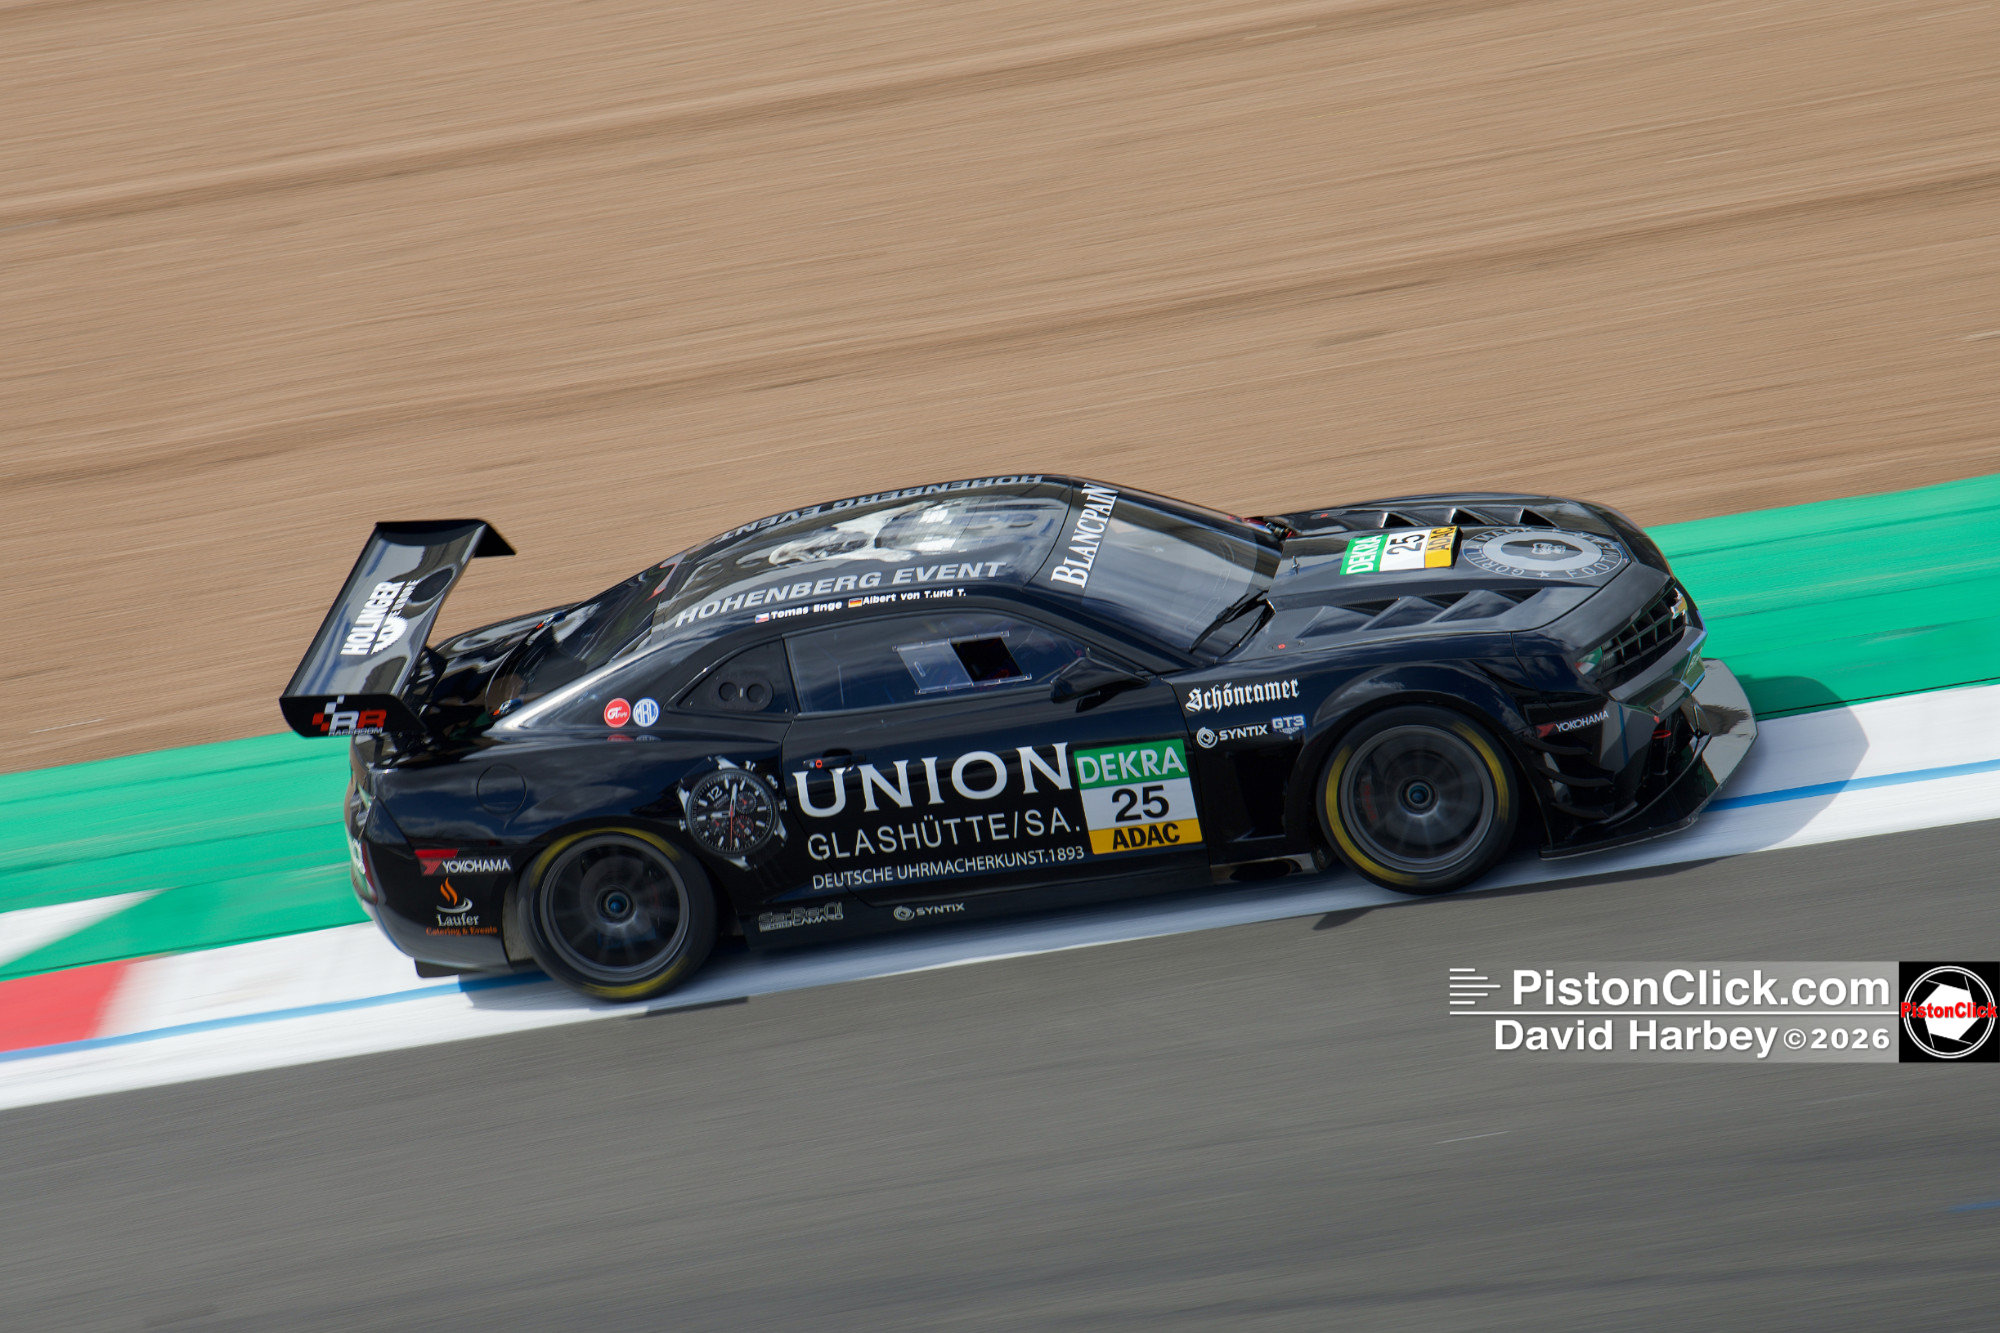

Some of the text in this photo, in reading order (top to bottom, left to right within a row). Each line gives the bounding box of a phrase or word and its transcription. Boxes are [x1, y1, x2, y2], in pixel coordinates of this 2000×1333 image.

[714, 474, 1044, 543] HOHENBERG EVENT
[1051, 483, 1119, 588] BLANCPAIN
[1387, 534, 1425, 555] 25
[1427, 527, 1455, 551] ADAC
[1346, 534, 1384, 575] DEKRA
[674, 561, 1006, 628] HOHENBERG EVENT
[862, 593, 897, 606] Albert
[900, 592, 920, 601] von
[957, 588, 967, 597] T.
[770, 601, 843, 620] Tomas Enge
[1185, 678, 1300, 713] Schönramer
[1219, 724, 1268, 741] SYNTIX
[1272, 714, 1305, 729] GT3
[1556, 710, 1609, 733] YOKOHAMA
[1076, 746, 1186, 785] DEKRA
[792, 742, 1074, 818] UNION
[706, 785, 723, 801] 12
[1111, 784, 1170, 823] 25
[1112, 822, 1181, 850] ADAC
[442, 859, 511, 874] YOKOHAMA
[812, 866, 894, 890] DEUTSCHE
[436, 913, 480, 927] Laufer
[916, 903, 965, 916] SYNTIX
